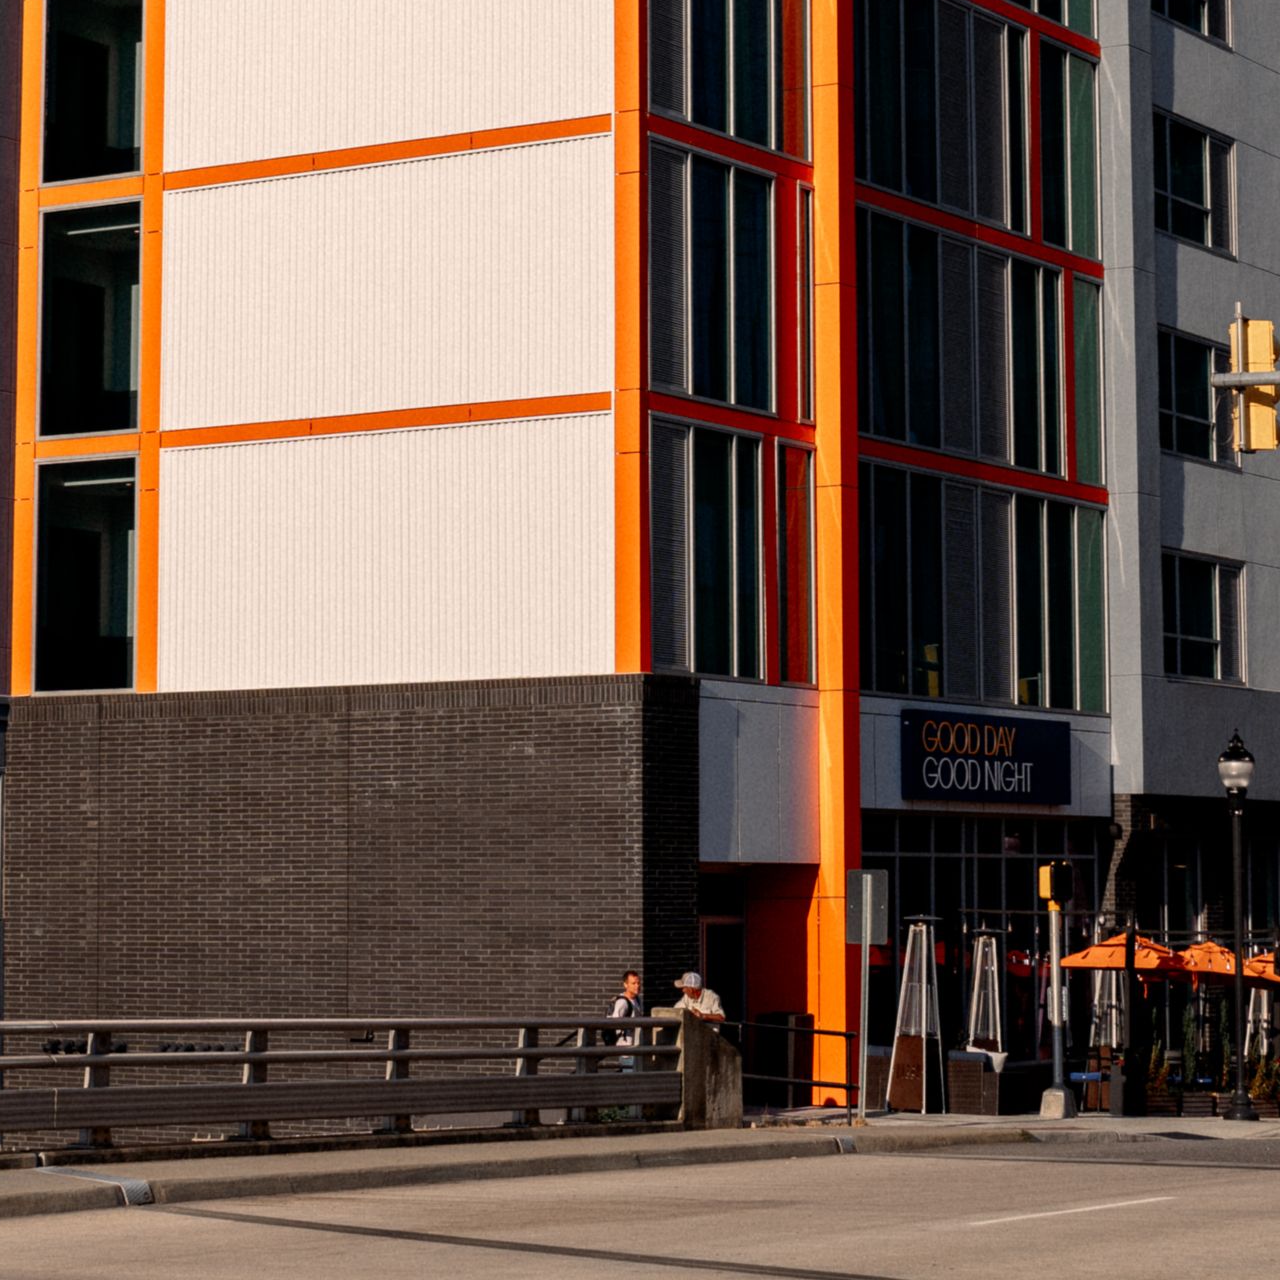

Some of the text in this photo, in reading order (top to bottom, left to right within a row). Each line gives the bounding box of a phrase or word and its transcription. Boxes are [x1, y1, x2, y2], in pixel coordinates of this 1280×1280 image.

[922, 720, 1016, 757] GOOD DAY
[922, 756, 1033, 793] GOOD NIGHT
